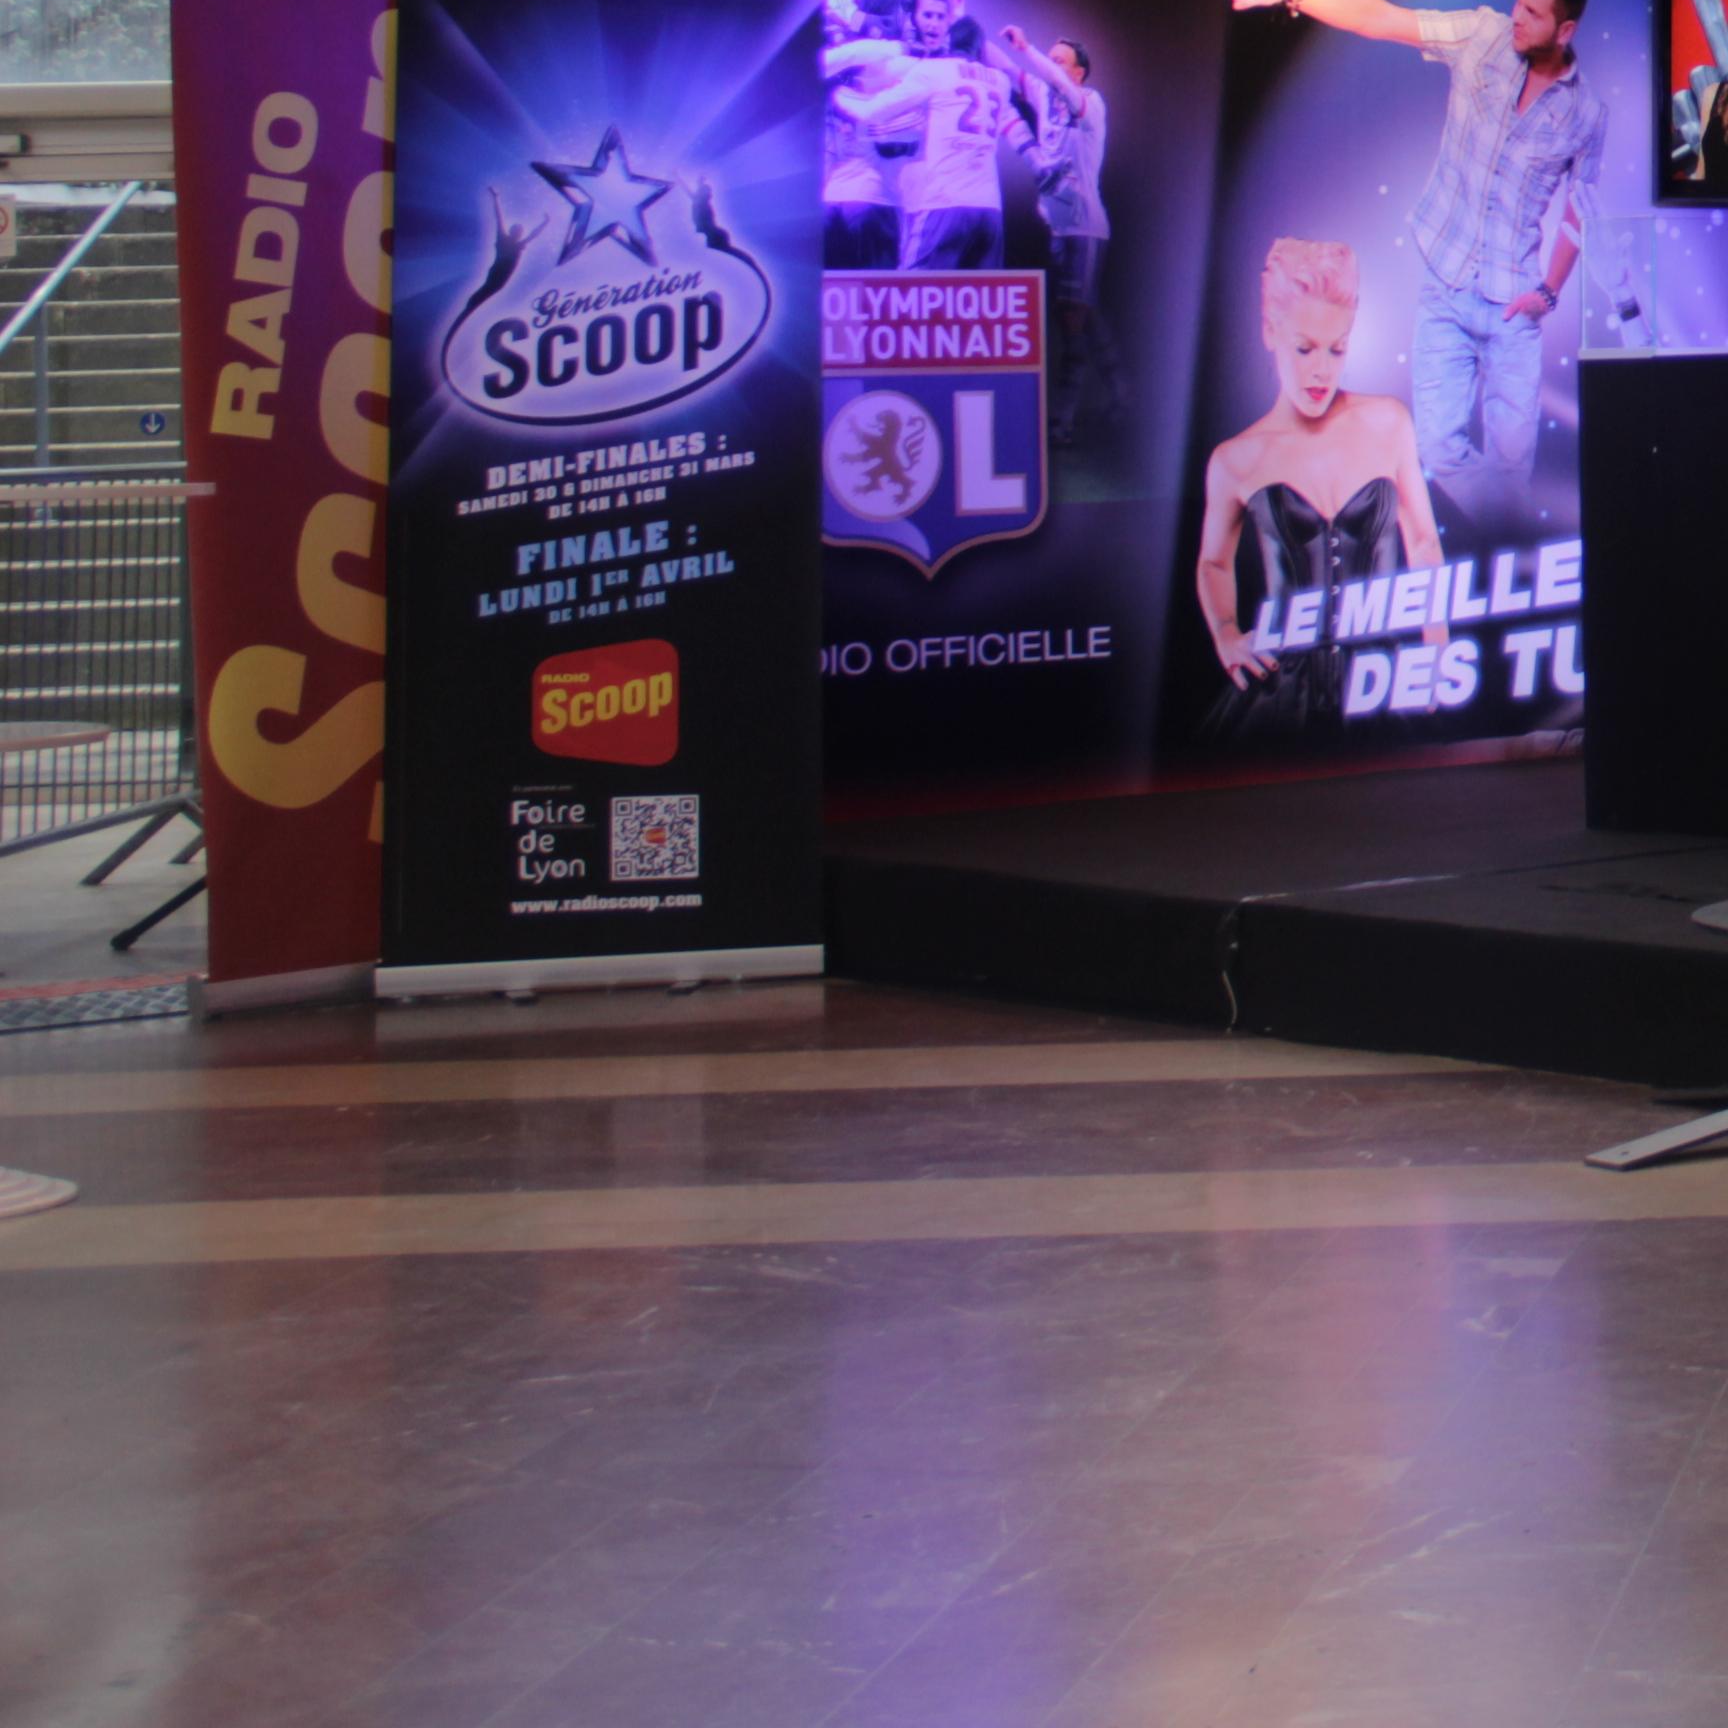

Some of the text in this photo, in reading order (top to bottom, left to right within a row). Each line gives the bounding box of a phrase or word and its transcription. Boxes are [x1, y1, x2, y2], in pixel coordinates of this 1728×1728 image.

[955, 85, 1001, 139] 23
[210, 91, 319, 440] RADIO
[531, 268, 703, 328] Génération
[822, 285, 1029, 322] OLYMPIQUE
[482, 290, 723, 399] Scoop
[823, 323, 1031, 361] LYONNAIS
[457, 489, 529, 516] SAMEDI
[533, 485, 557, 502] 30
[579, 464, 675, 495] DIMANCHE
[678, 461, 698, 478] 31
[704, 450, 756, 473] MARS
[486, 431, 707, 491] DEMI-FINALES
[548, 502, 572, 520] DE
[579, 495, 611, 515] 14H
[635, 485, 667, 504] 16H
[516, 520, 670, 576] FINALE
[478, 577, 578, 618] LUNDI
[641, 549, 735, 588] AVRIL
[548, 607, 572, 625] DE
[579, 600, 611, 619] 14H
[635, 590, 667, 609] 16H
[1253, 538, 1583, 652] LE MEILLE
[885, 626, 1112, 673] OFFICIELLE
[540, 673, 590, 684] RADIO
[540, 671, 673, 735] Scoop
[1344, 639, 1479, 716] DES
[511, 799, 587, 825] Foire
[518, 829, 556, 854] de
[518, 855, 587, 885] Lyon
[510, 893, 703, 914] www.radioscoop.com
